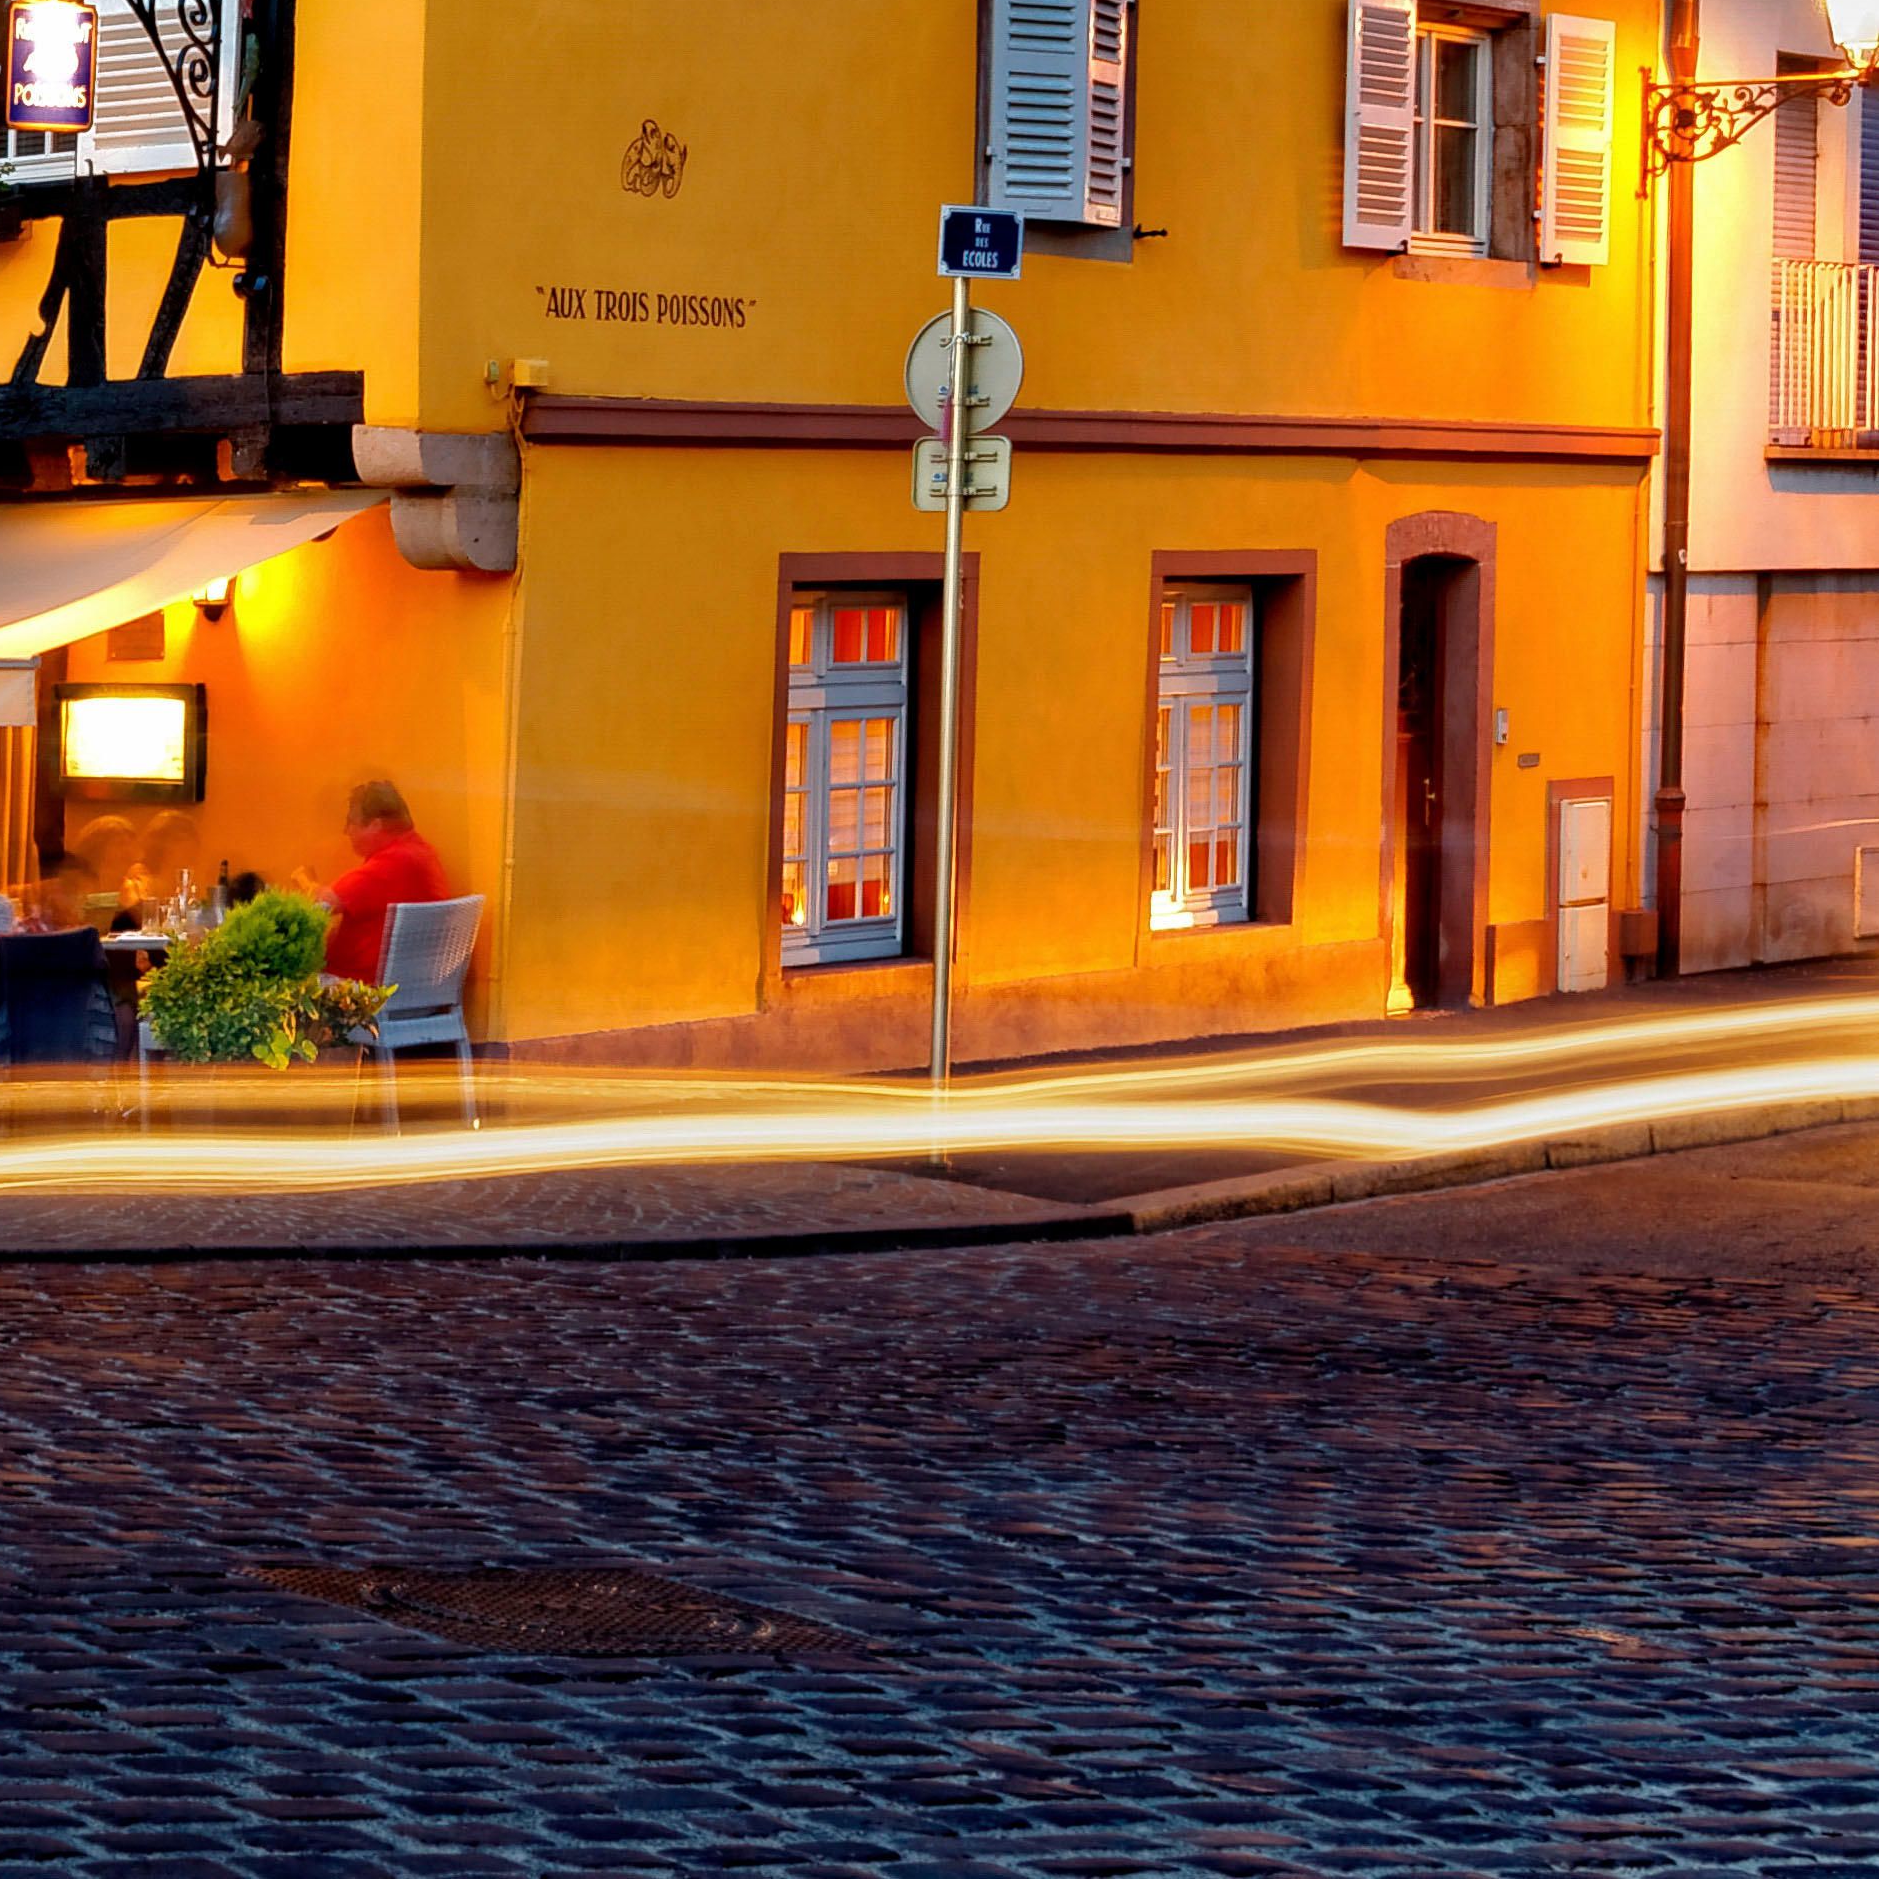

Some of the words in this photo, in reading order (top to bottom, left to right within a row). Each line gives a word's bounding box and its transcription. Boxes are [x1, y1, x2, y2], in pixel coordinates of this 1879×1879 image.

[974, 217, 992, 234] RUE
[962, 249, 999, 269] ECOLES
[594, 289, 649, 322] TROIS
